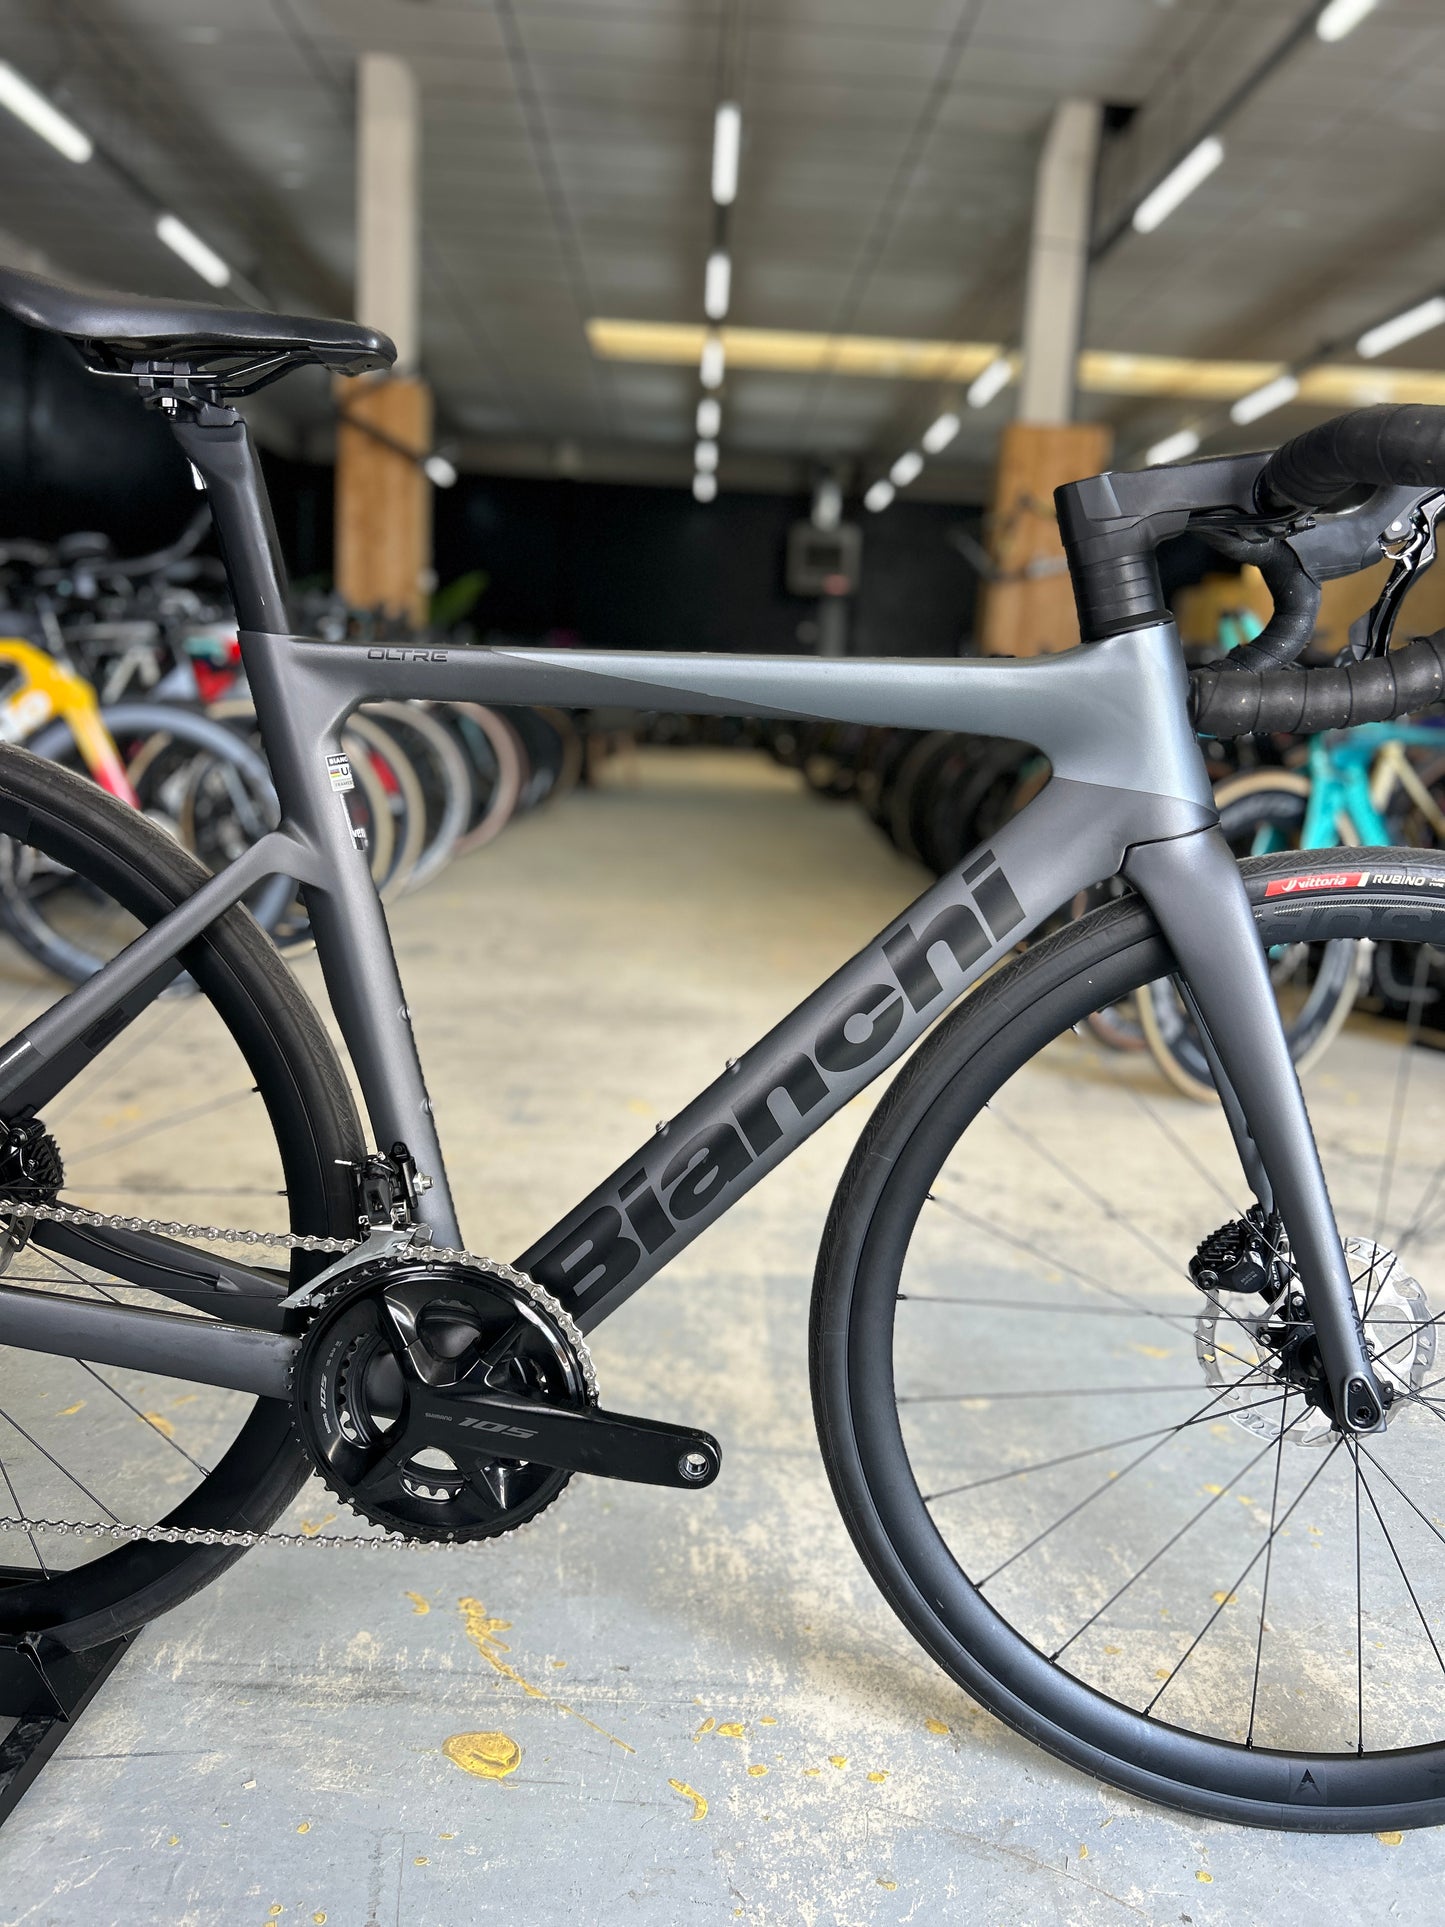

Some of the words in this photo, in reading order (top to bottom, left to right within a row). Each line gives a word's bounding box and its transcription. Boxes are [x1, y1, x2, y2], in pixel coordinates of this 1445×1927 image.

[368, 649, 448, 662] OLTRE
[1297, 875, 1348, 888] vittoria
[1373, 874, 1426, 887] RUBINO
[530, 849, 1026, 1305] Bianchi
[458, 1417, 539, 1439] 105
